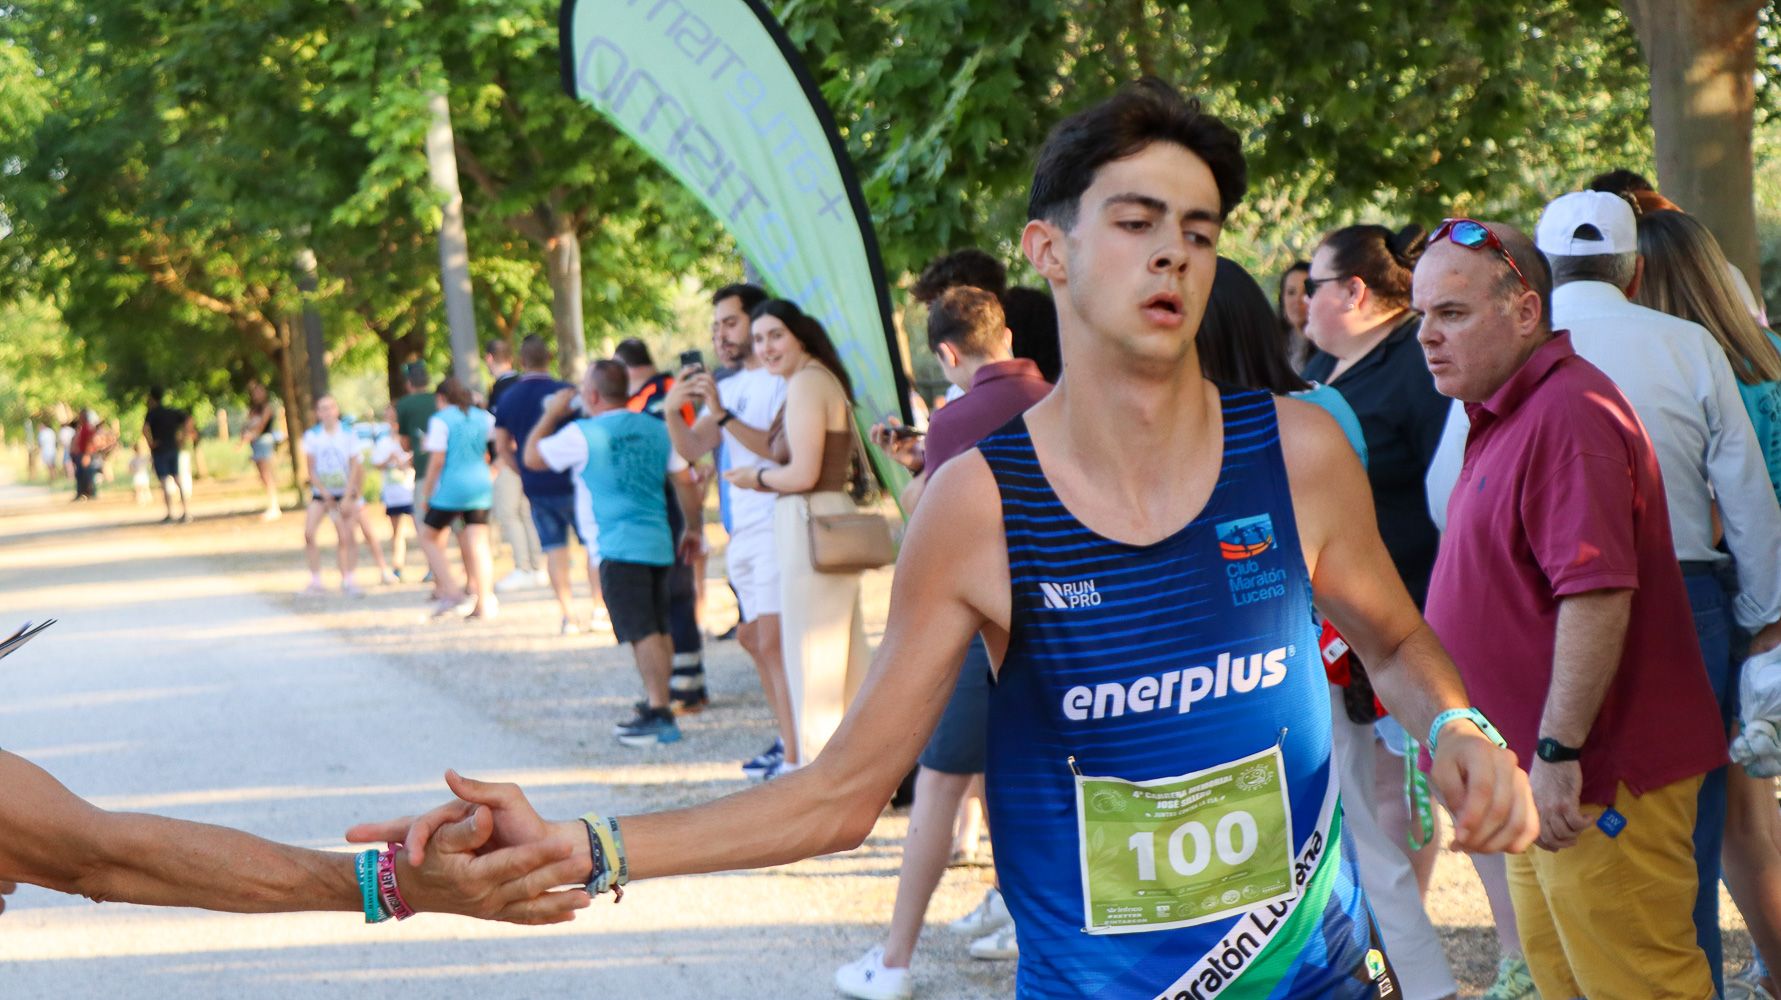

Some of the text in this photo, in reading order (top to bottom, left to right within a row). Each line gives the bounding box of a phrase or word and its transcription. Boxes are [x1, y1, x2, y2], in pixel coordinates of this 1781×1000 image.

[1226, 560, 1259, 578] Club
[1229, 567, 1286, 592] Maratón
[1063, 579, 1095, 596] RUN
[1069, 591, 1102, 608] PRO
[1232, 583, 1286, 607] Lucena
[1129, 810, 1259, 881] 100
[1160, 939, 1261, 1000] ratón
